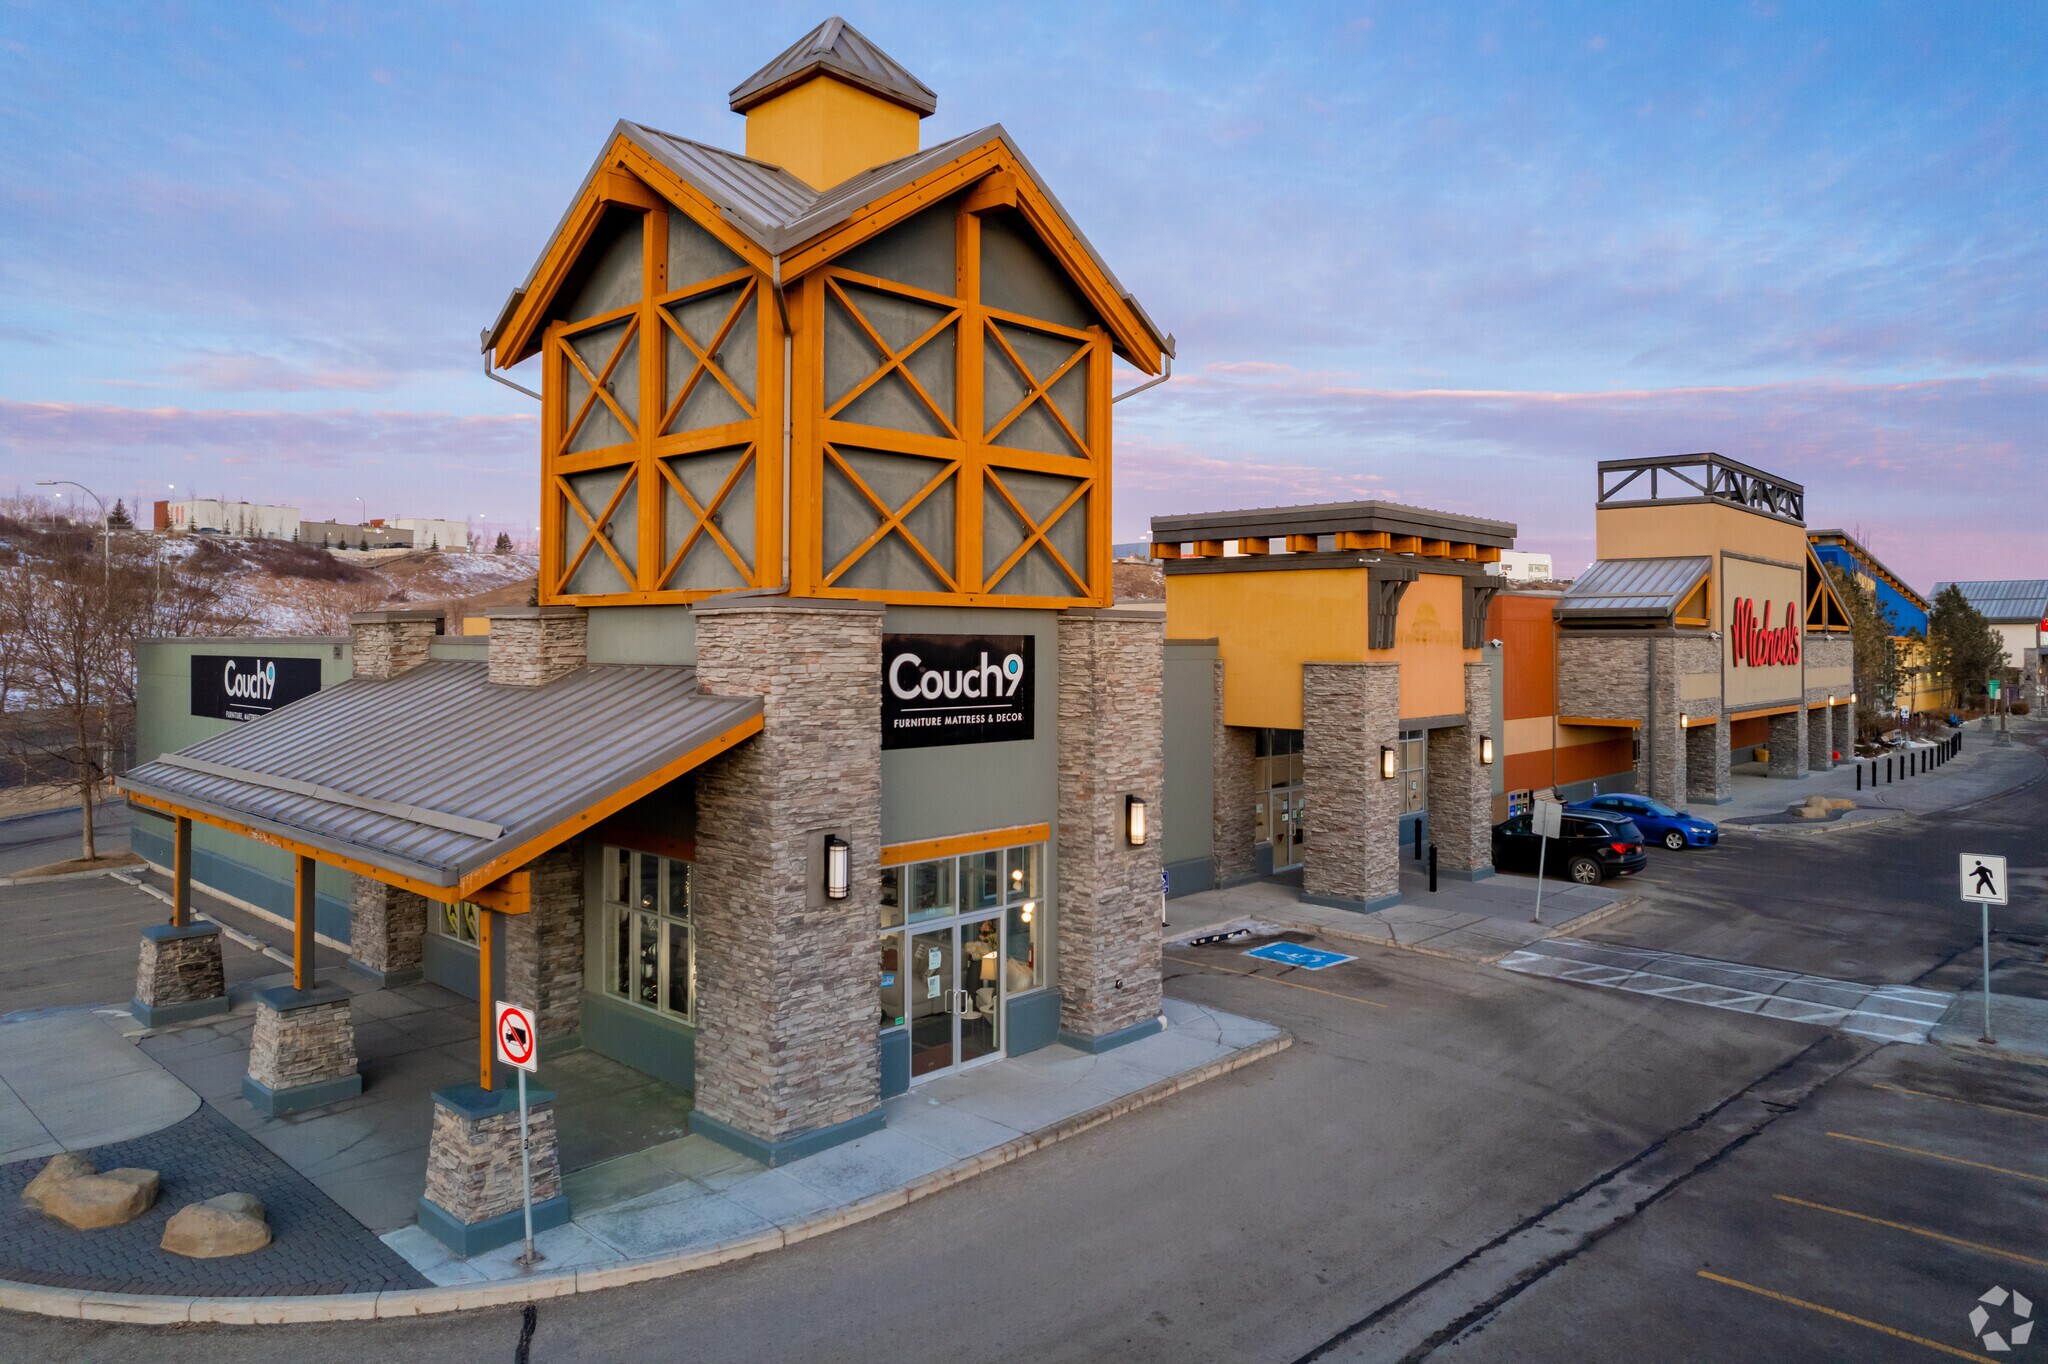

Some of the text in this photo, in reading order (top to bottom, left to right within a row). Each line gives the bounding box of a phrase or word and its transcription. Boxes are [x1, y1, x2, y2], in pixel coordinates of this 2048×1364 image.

[1730, 596, 1801, 668] Michaels
[224, 659, 276, 700] Couch9
[889, 651, 1024, 700] Couch9
[893, 712, 1023, 729] FURNITURE MATTRESS & DECOR
